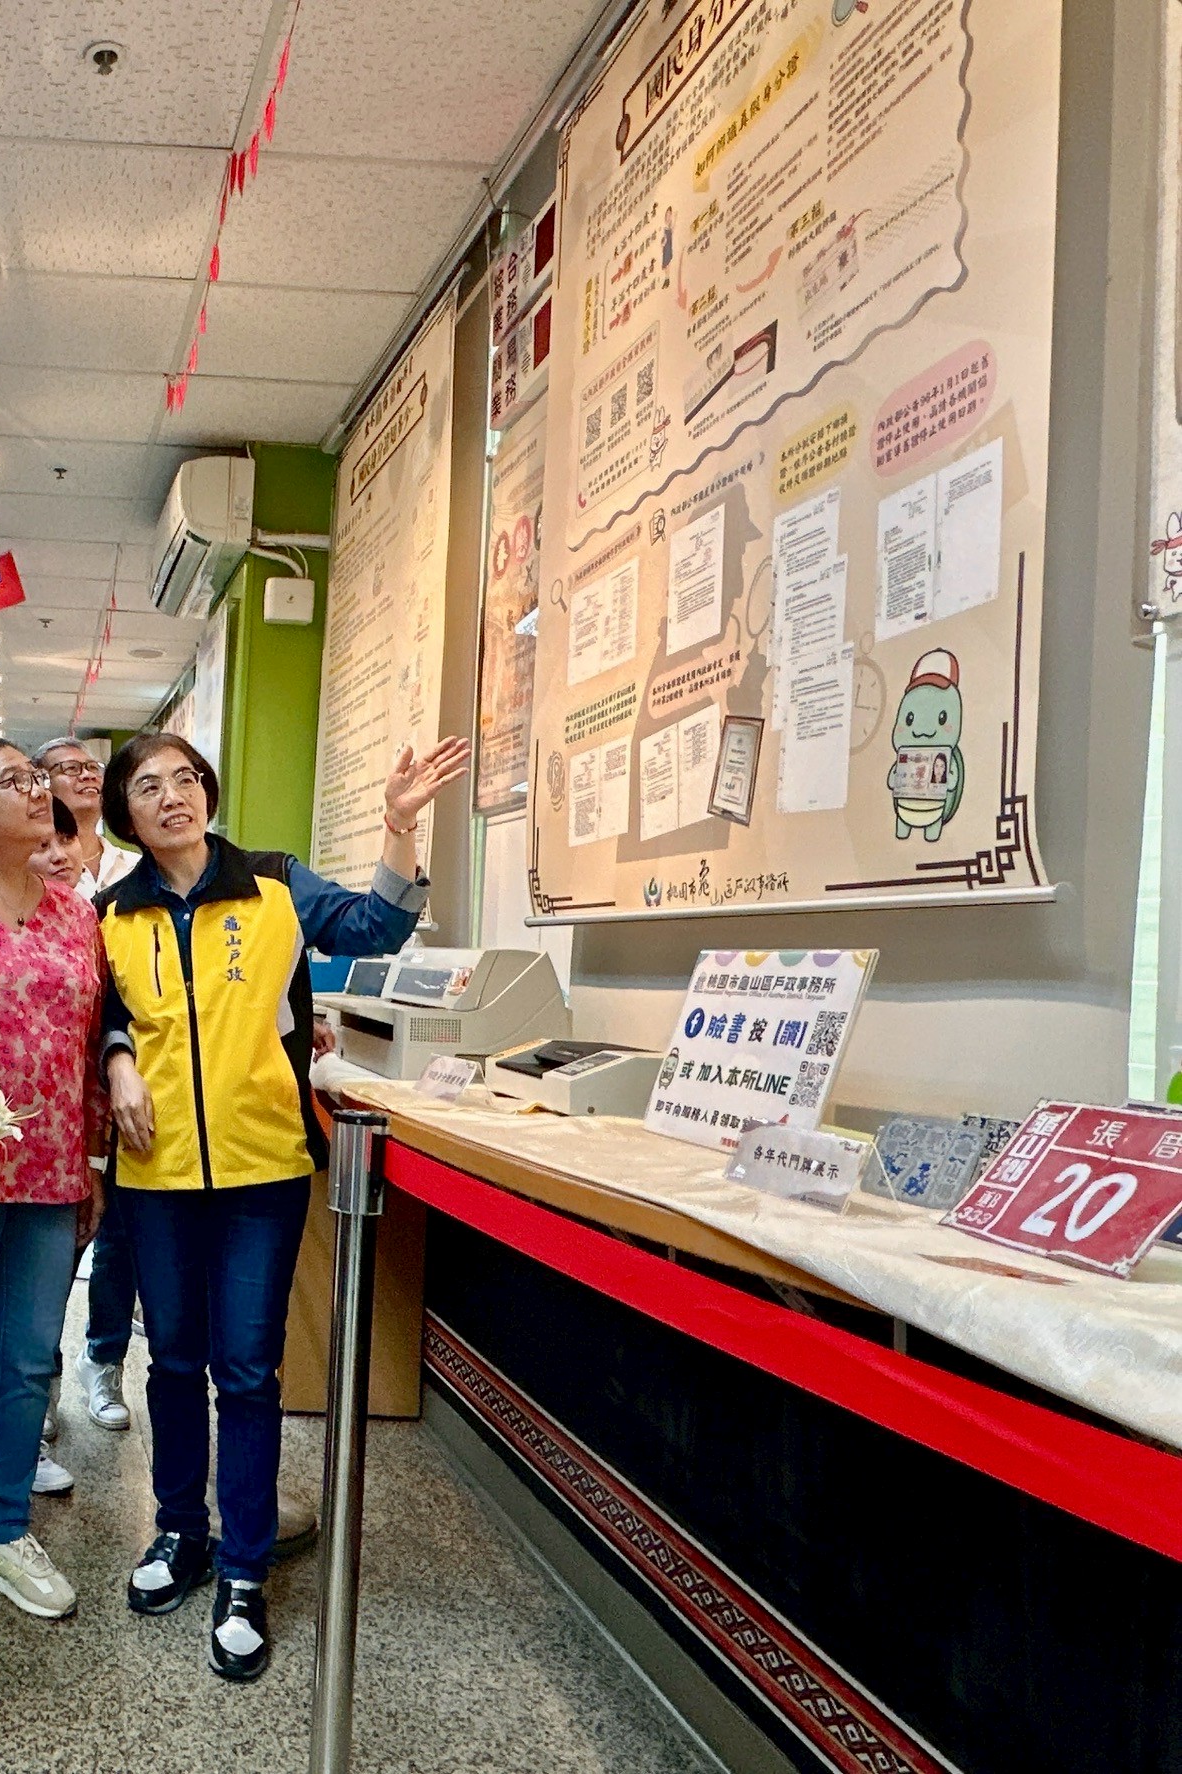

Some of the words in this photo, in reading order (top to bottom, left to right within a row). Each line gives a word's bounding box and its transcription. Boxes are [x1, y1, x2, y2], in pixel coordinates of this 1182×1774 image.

[223, 914, 247, 983] 龜山戶政
[706, 974, 837, 994] 桃園市龜山區戶政事務所
[705, 1012, 747, 1045] 臉書
[748, 1018, 769, 1043] 按
[678, 1060, 695, 1079] 或
[696, 1062, 792, 1096] 加入本所LINE
[990, 1109, 1070, 1184] 龜山鄉
[957, 1206, 994, 1226] 333
[1018, 1162, 1139, 1243] 20
